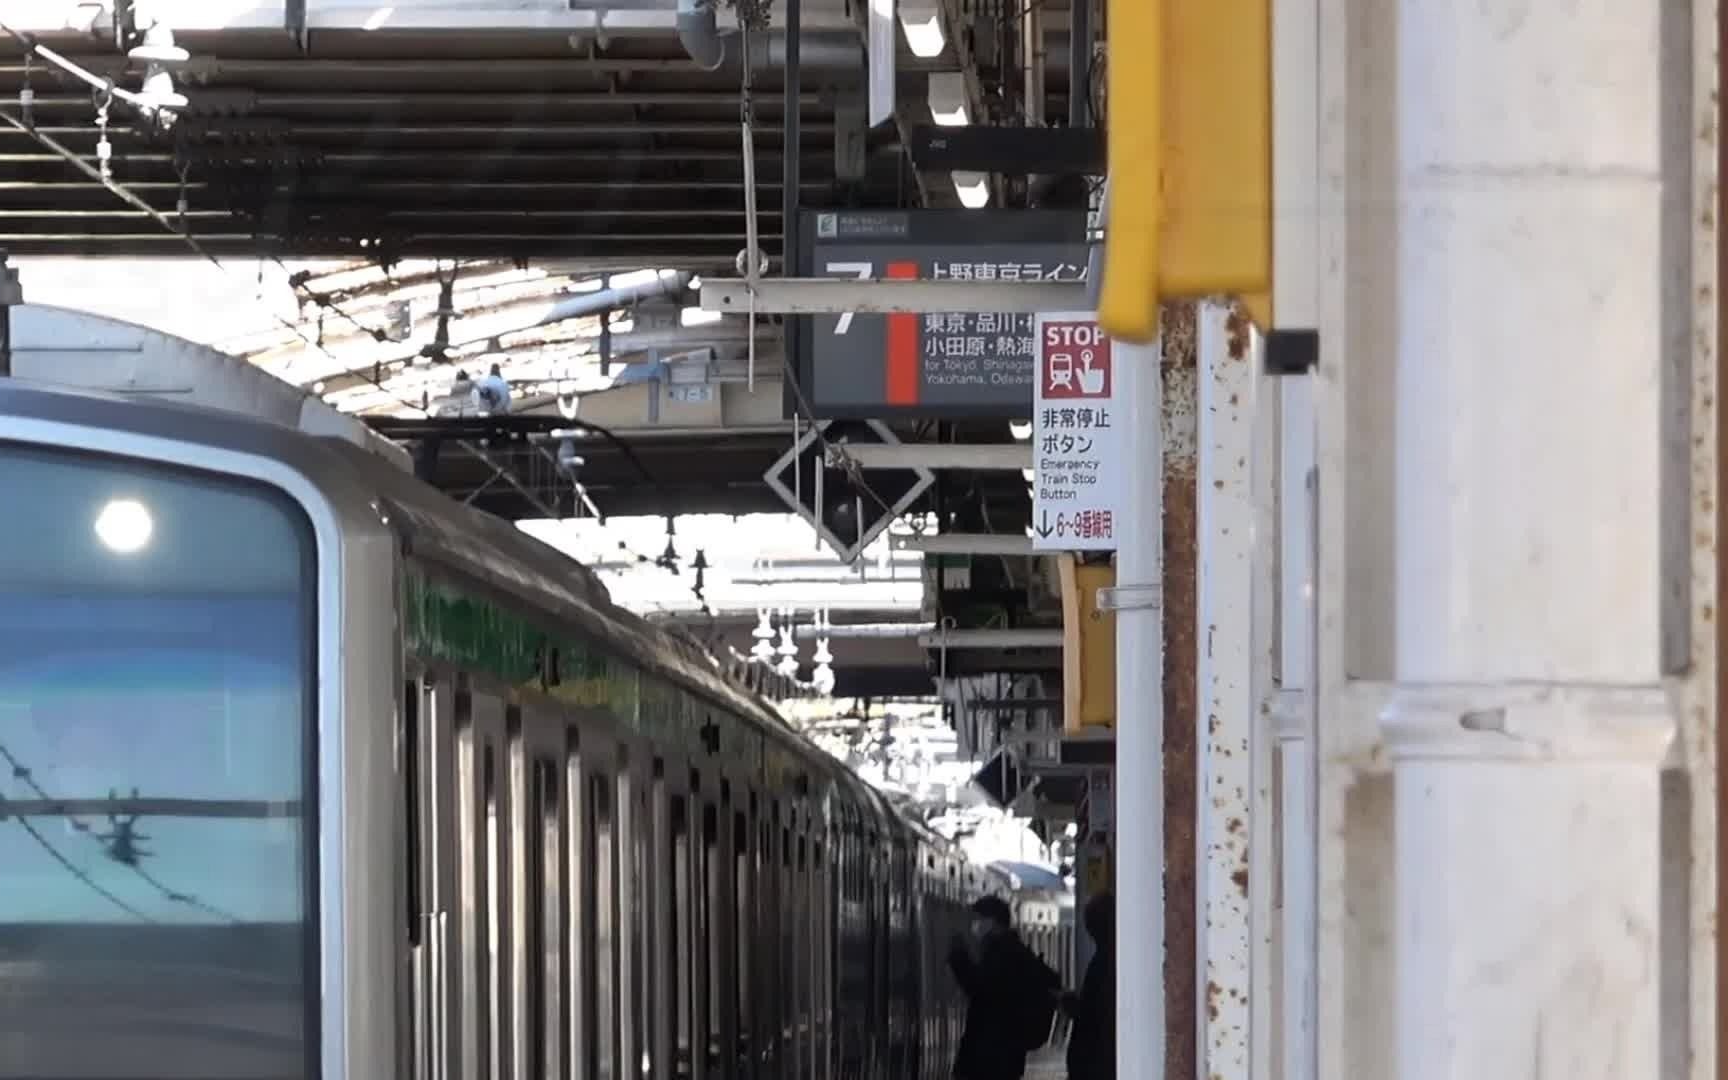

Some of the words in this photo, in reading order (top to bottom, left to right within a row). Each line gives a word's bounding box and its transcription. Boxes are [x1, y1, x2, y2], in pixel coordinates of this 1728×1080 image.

[825, 262, 872, 335] 7
[1047, 326, 1105, 346] STOP
[1042, 408, 1111, 428] 非常停止
[1042, 434, 1093, 454] ボタン
[1040, 459, 1099, 470] Emergency
[1042, 474, 1069, 484] Train
[1071, 473, 1097, 485] Stop
[1040, 488, 1077, 499] Button
